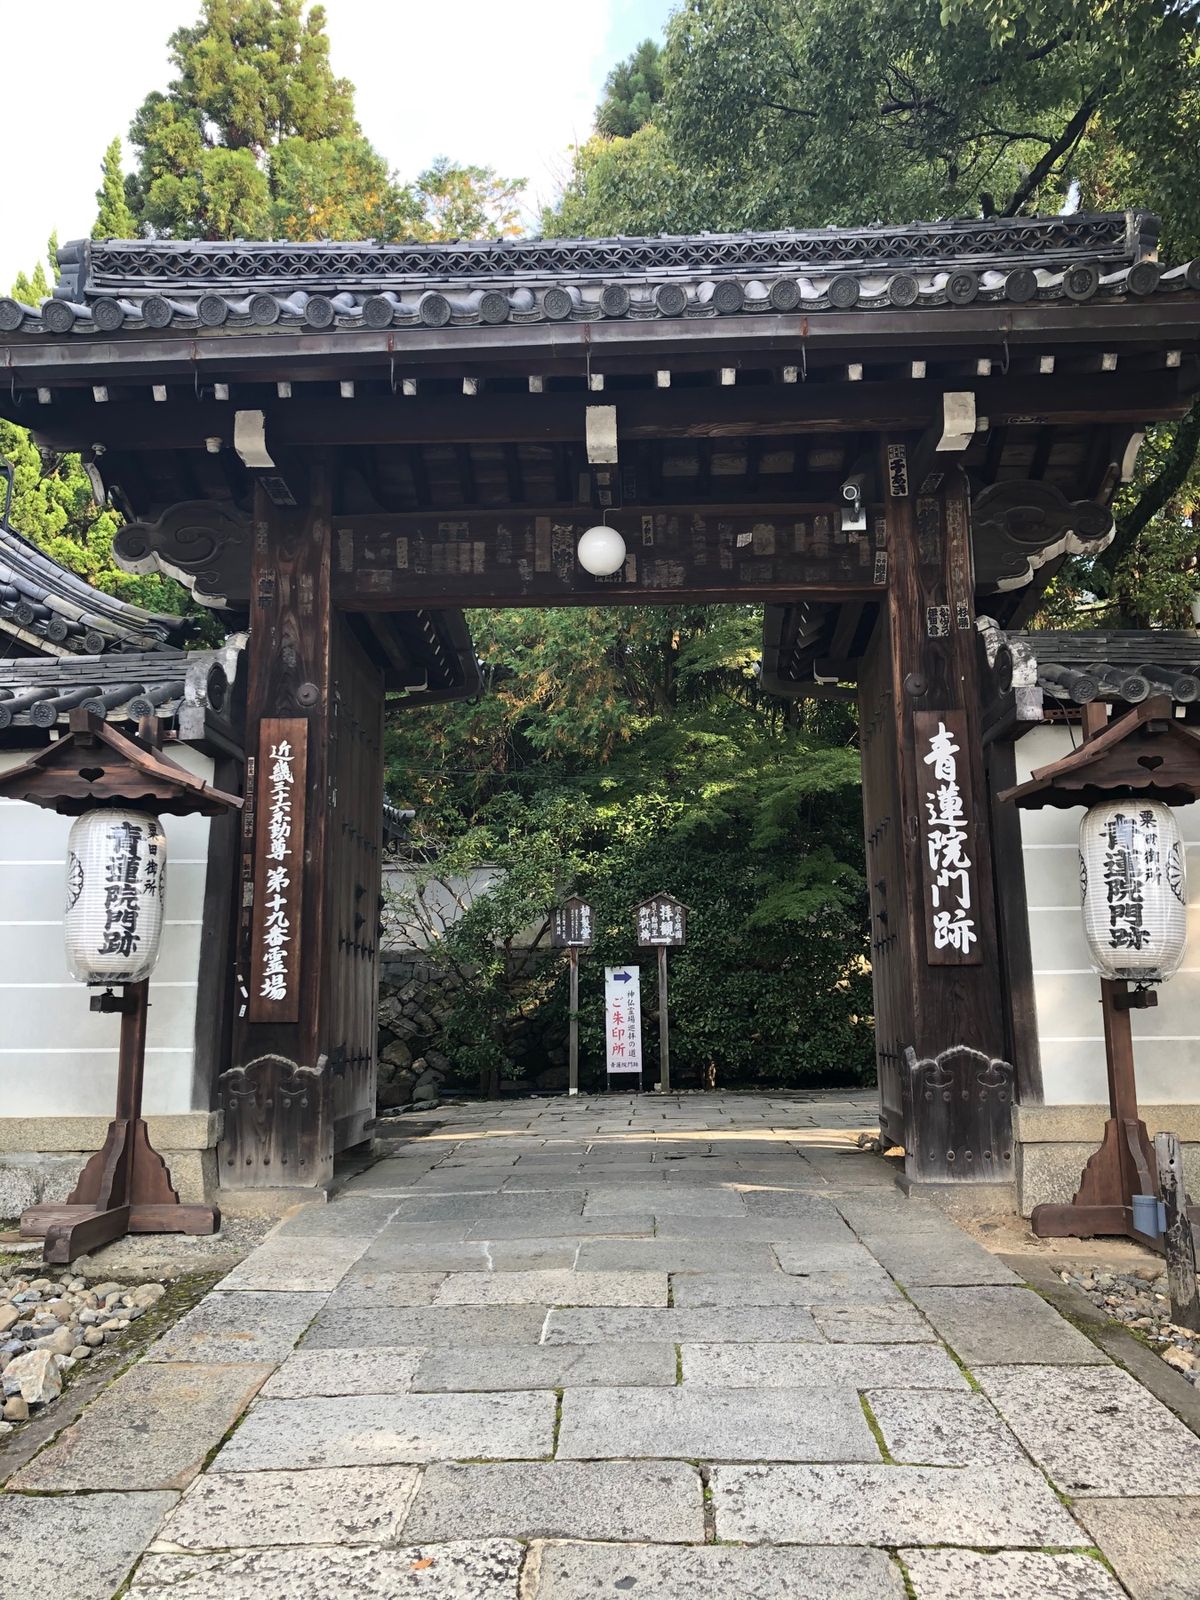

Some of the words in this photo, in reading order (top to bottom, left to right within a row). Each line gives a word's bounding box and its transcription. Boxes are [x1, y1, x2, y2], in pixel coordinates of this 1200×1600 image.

[98, 821, 143, 957] 青蓮院門跡
[924, 722, 977, 954] 青蓮院門跡
[612, 996, 626, 1057] ご朱印所
